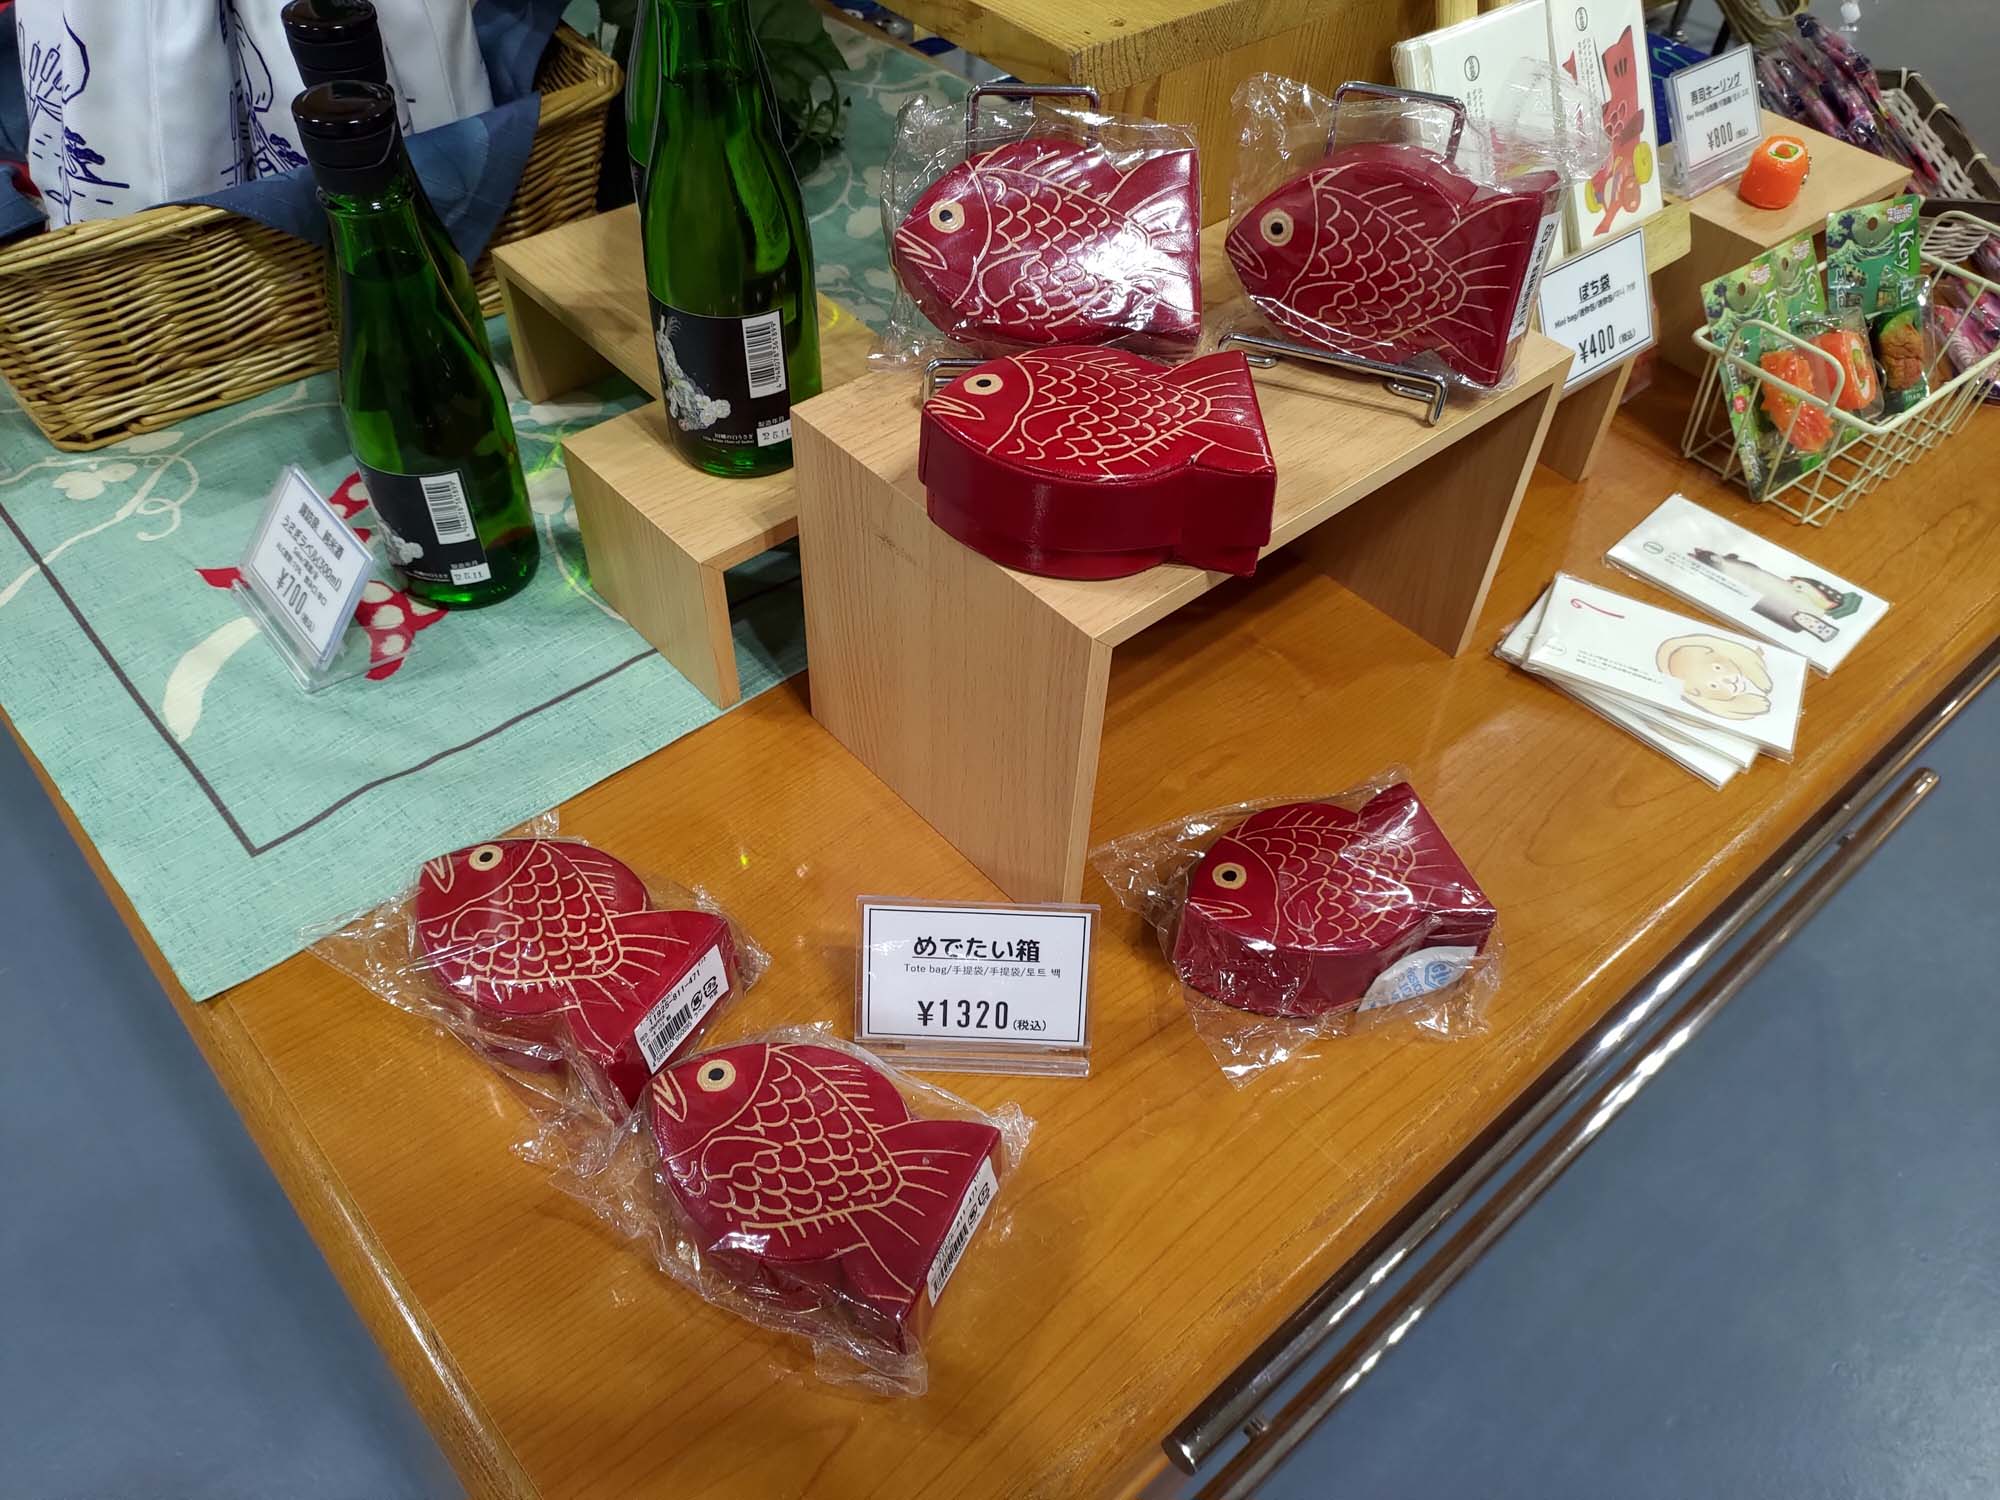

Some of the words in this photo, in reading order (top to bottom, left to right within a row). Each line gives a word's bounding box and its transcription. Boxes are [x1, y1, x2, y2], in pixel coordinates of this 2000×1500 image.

[1690, 72, 1741, 105] 寿司キーリング
[1706, 121, 1733, 150] ¥800
[1895, 229, 1914, 269] Key
[1578, 273, 1611, 302] ぽち袋
[1805, 267, 1818, 304] Key
[1578, 324, 1615, 363] ¥400
[276, 567, 308, 616] ¥700
[913, 936, 1040, 962] めでたい箱
[904, 963, 926, 974] Tote
[648, 968, 701, 1025] 11925-811-471
[917, 999, 1009, 1030] ¥1320
[1012, 1019, 1047, 1032] (税込)
